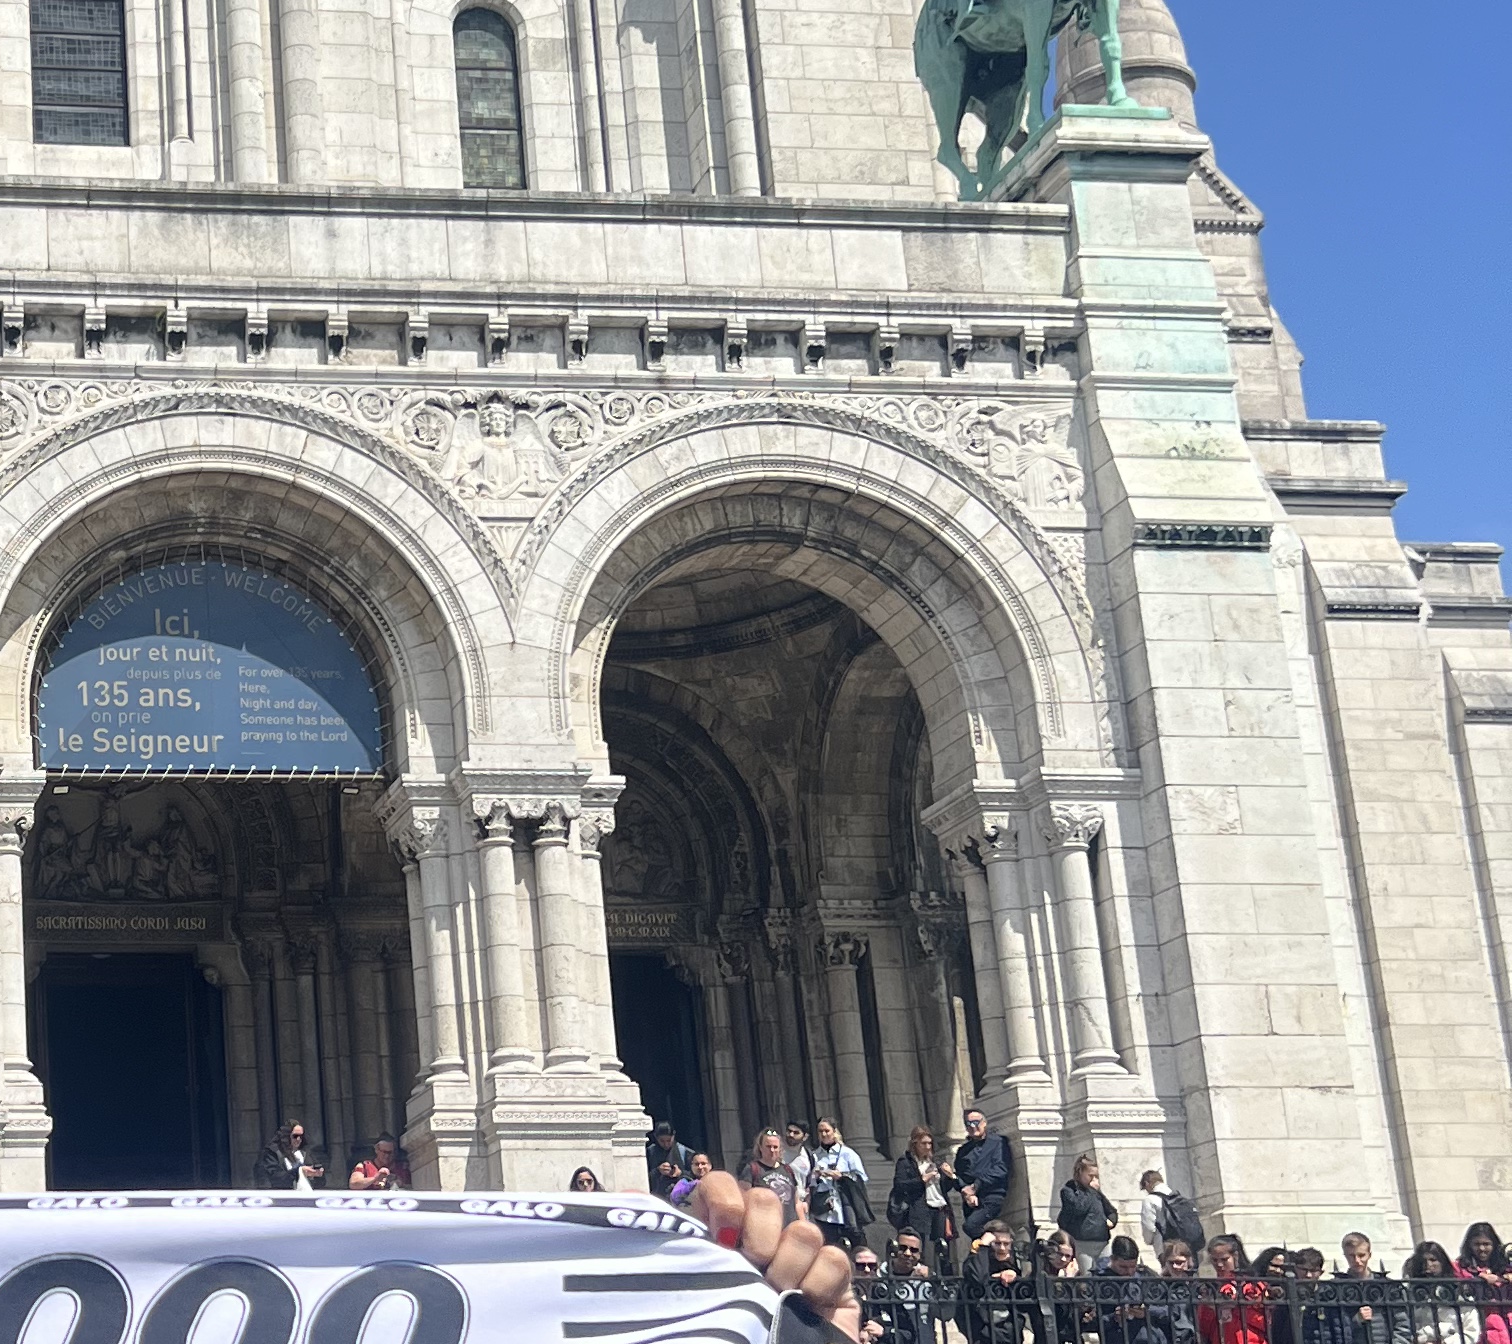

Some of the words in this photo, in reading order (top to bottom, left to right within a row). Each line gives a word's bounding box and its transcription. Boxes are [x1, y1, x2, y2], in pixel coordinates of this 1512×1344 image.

[87, 567, 205, 630] BIENVENUE
[224, 570, 325, 634] WELCOME
[155, 608, 199, 640] Ici,
[98, 644, 141, 665] jour
[148, 645, 168, 661] et
[175, 643, 221, 664] nuit,
[126, 667, 169, 682] depuis
[174, 667, 201, 682] plus
[205, 668, 221, 680] de
[238, 665, 257, 677] For
[260, 668, 283, 677] over
[77, 681, 128, 707] 135
[139, 687, 201, 711] ans,
[240, 697, 271, 711] Night
[273, 698, 295, 709] and
[91, 712, 111, 723] on
[118, 709, 151, 727] prie
[240, 712, 294, 725] Someone
[297, 714, 317, 726] has
[59, 727, 83, 752] le
[93, 727, 225, 759] Seigneur
[241, 730, 283, 744] praying
[286, 731, 297, 741] to
[299, 729, 318, 741] the
[321, 730, 347, 742] Lord
[36, 915, 126, 930] SACRATISSIMO
[131, 915, 169, 930] CORDI
[460, 1199, 565, 1219] GALO
